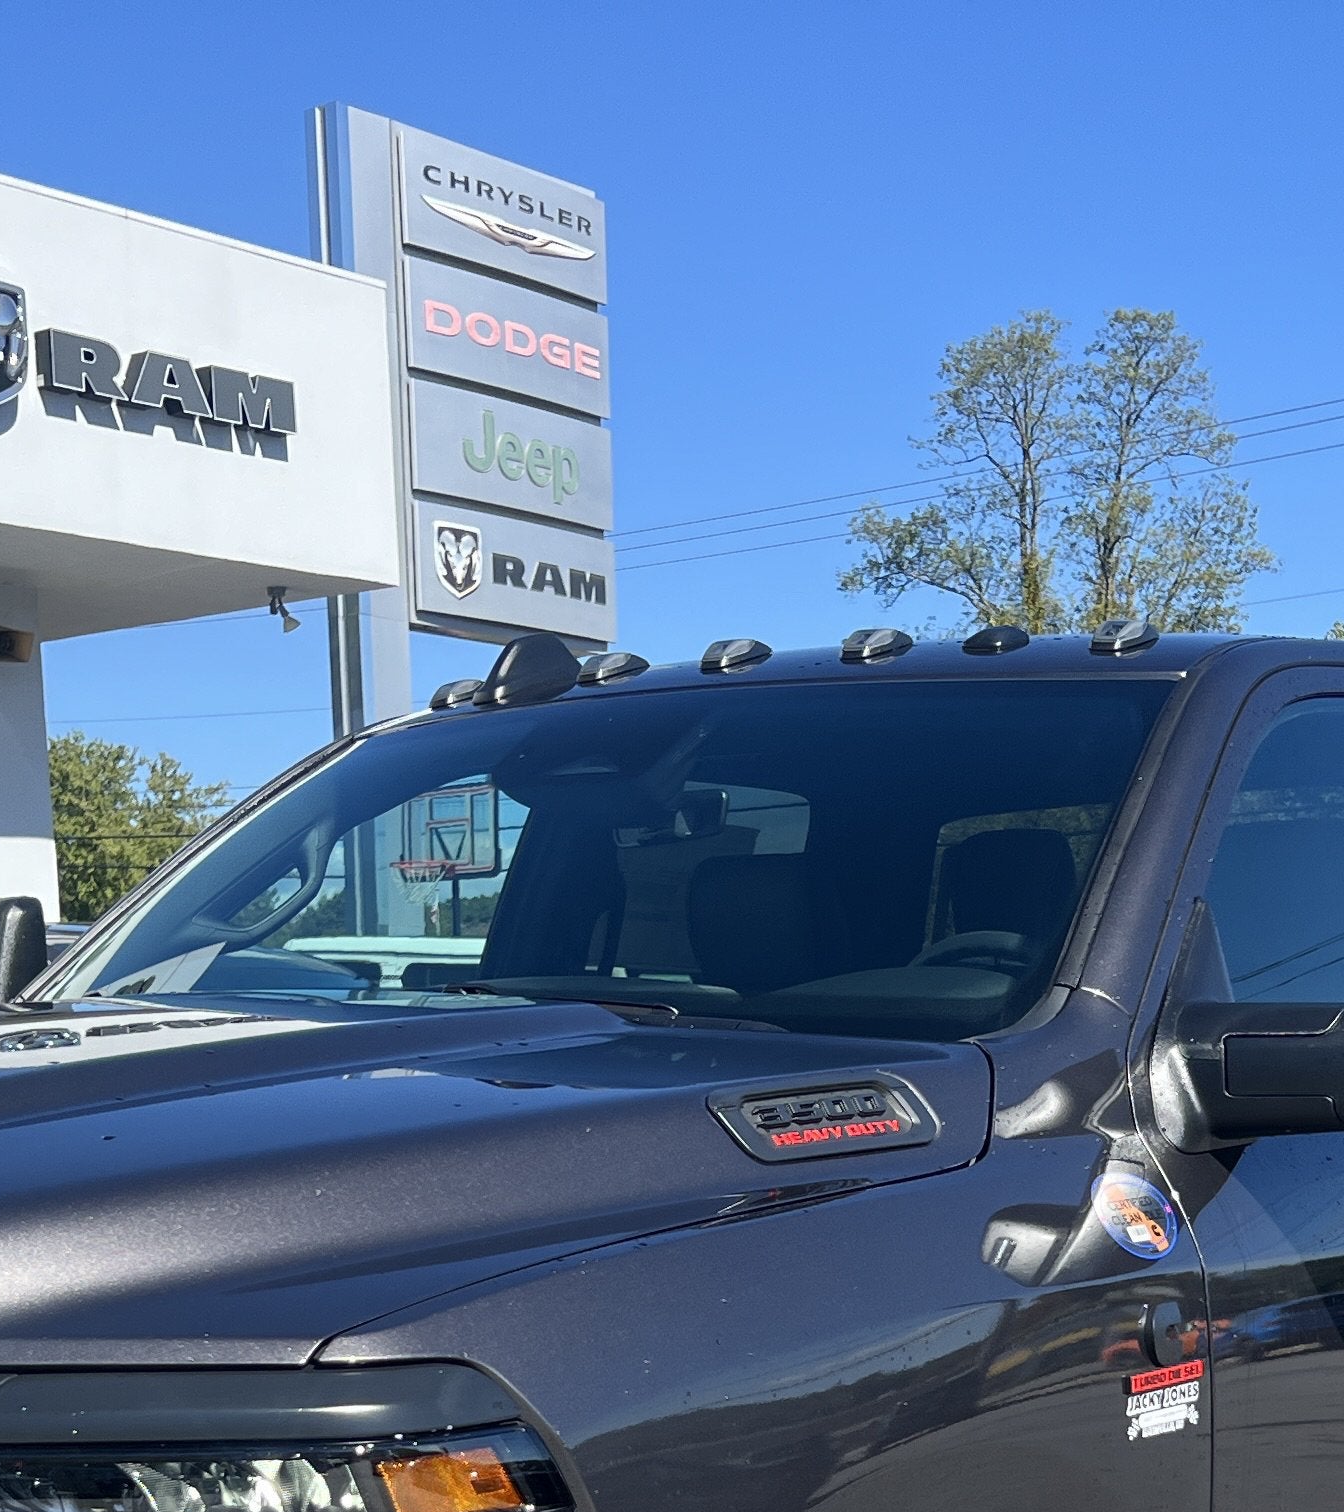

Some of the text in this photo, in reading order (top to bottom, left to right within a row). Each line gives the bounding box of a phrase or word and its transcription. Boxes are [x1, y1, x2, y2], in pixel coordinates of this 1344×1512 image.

[422, 163, 593, 237] CHRYSLER
[423, 298, 601, 380] DODGE
[36, 328, 298, 436] RAM
[462, 408, 581, 505] Jeep
[491, 552, 607, 606] RAM
[770, 1119, 901, 1147] HEAVY DUTY
[1111, 1212, 1144, 1226] CLEAN
[1127, 1381, 1200, 1416] JACKY JONES
